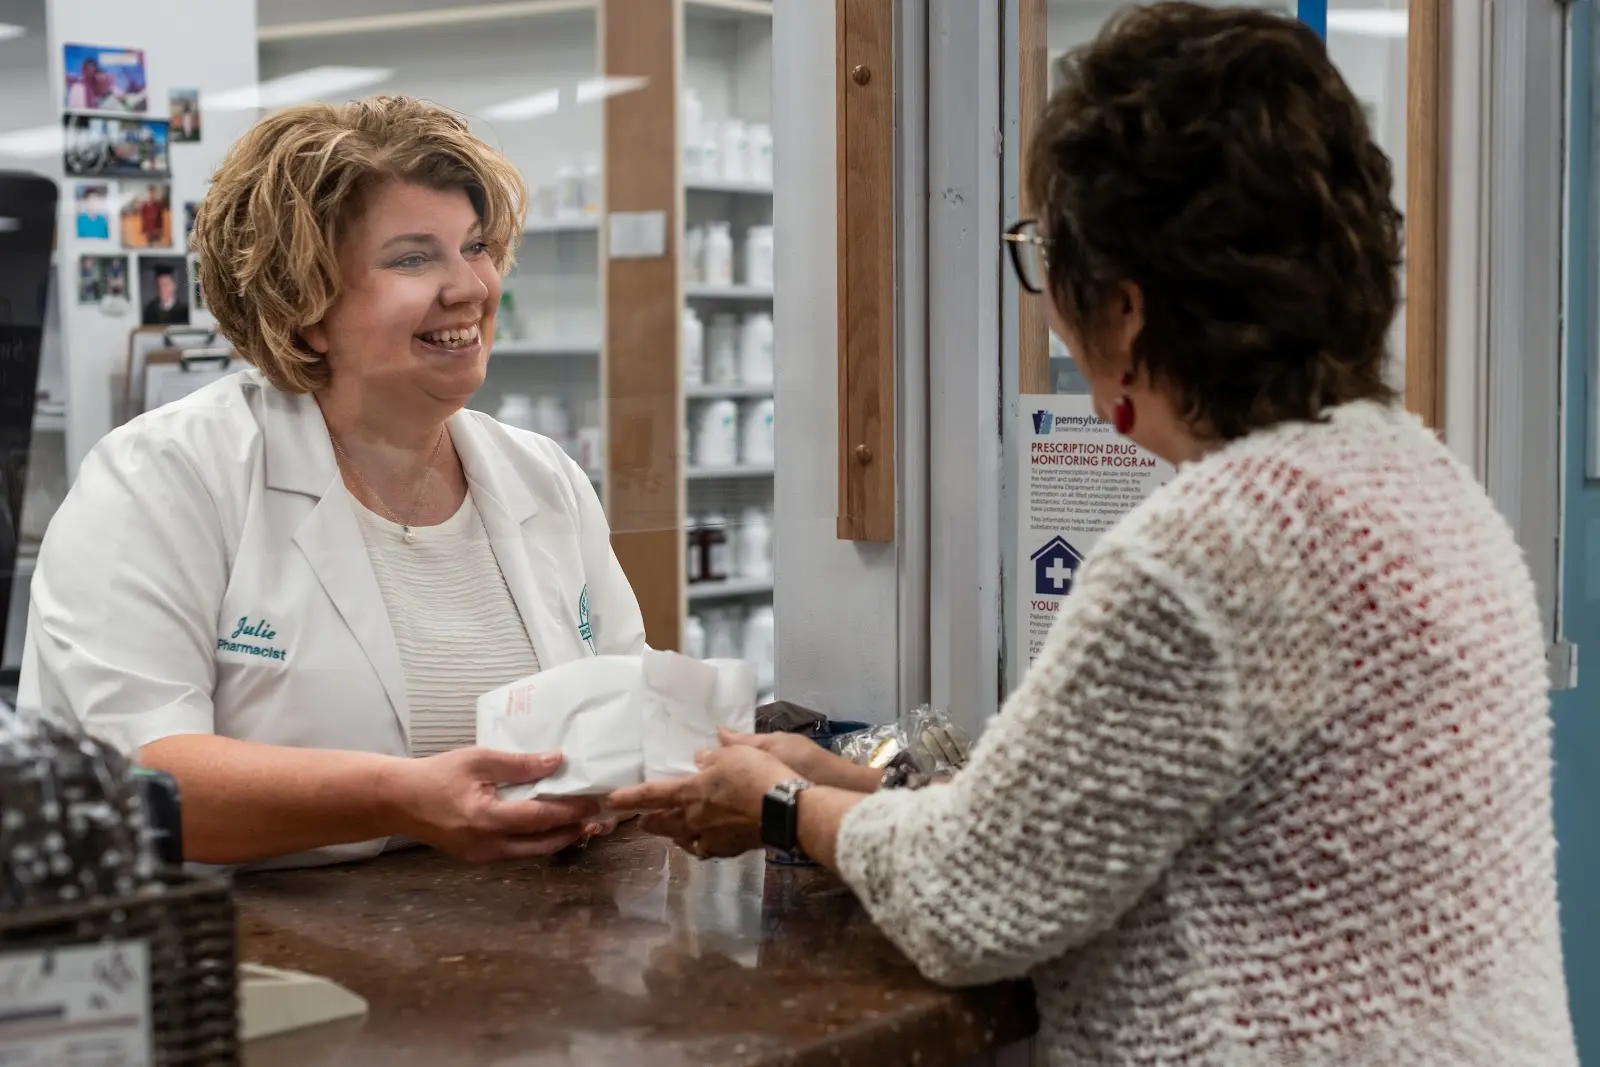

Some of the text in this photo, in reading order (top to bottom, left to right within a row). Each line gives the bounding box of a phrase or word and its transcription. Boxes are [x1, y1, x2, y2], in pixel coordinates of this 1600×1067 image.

[1031, 442, 1137, 455] PRESCRIPTION DRUG
[1031, 455, 1156, 467] MONITORING PROGRAM
[1030, 600, 1060, 611] YOUR
[231, 616, 277, 639] Julie
[217, 638, 287, 661] Pharmacist
